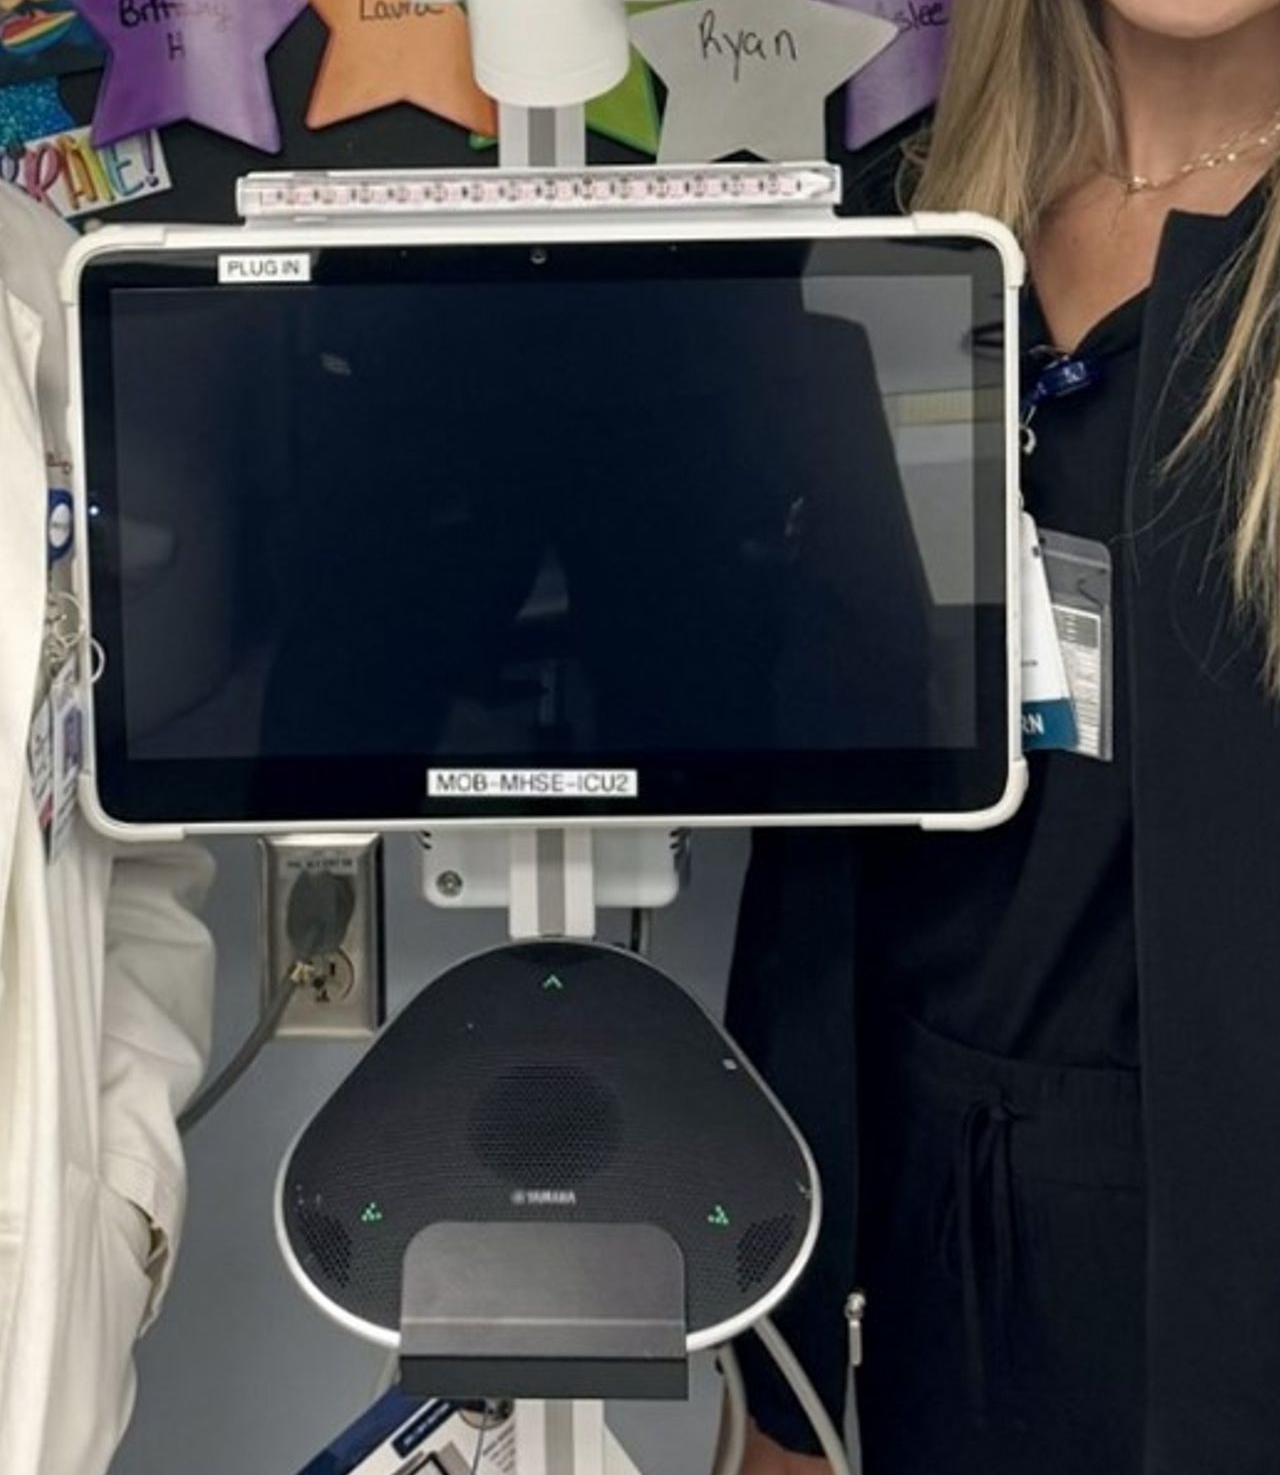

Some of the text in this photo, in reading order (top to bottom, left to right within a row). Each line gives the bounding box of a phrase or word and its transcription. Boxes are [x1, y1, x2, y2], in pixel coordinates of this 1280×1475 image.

[167, 29, 187, 61] H
[698, 9, 798, 83] Ryan
[226, 259, 301, 277] PLUG IN
[435, 772, 629, 793] MOB-MHSE-ICU2
